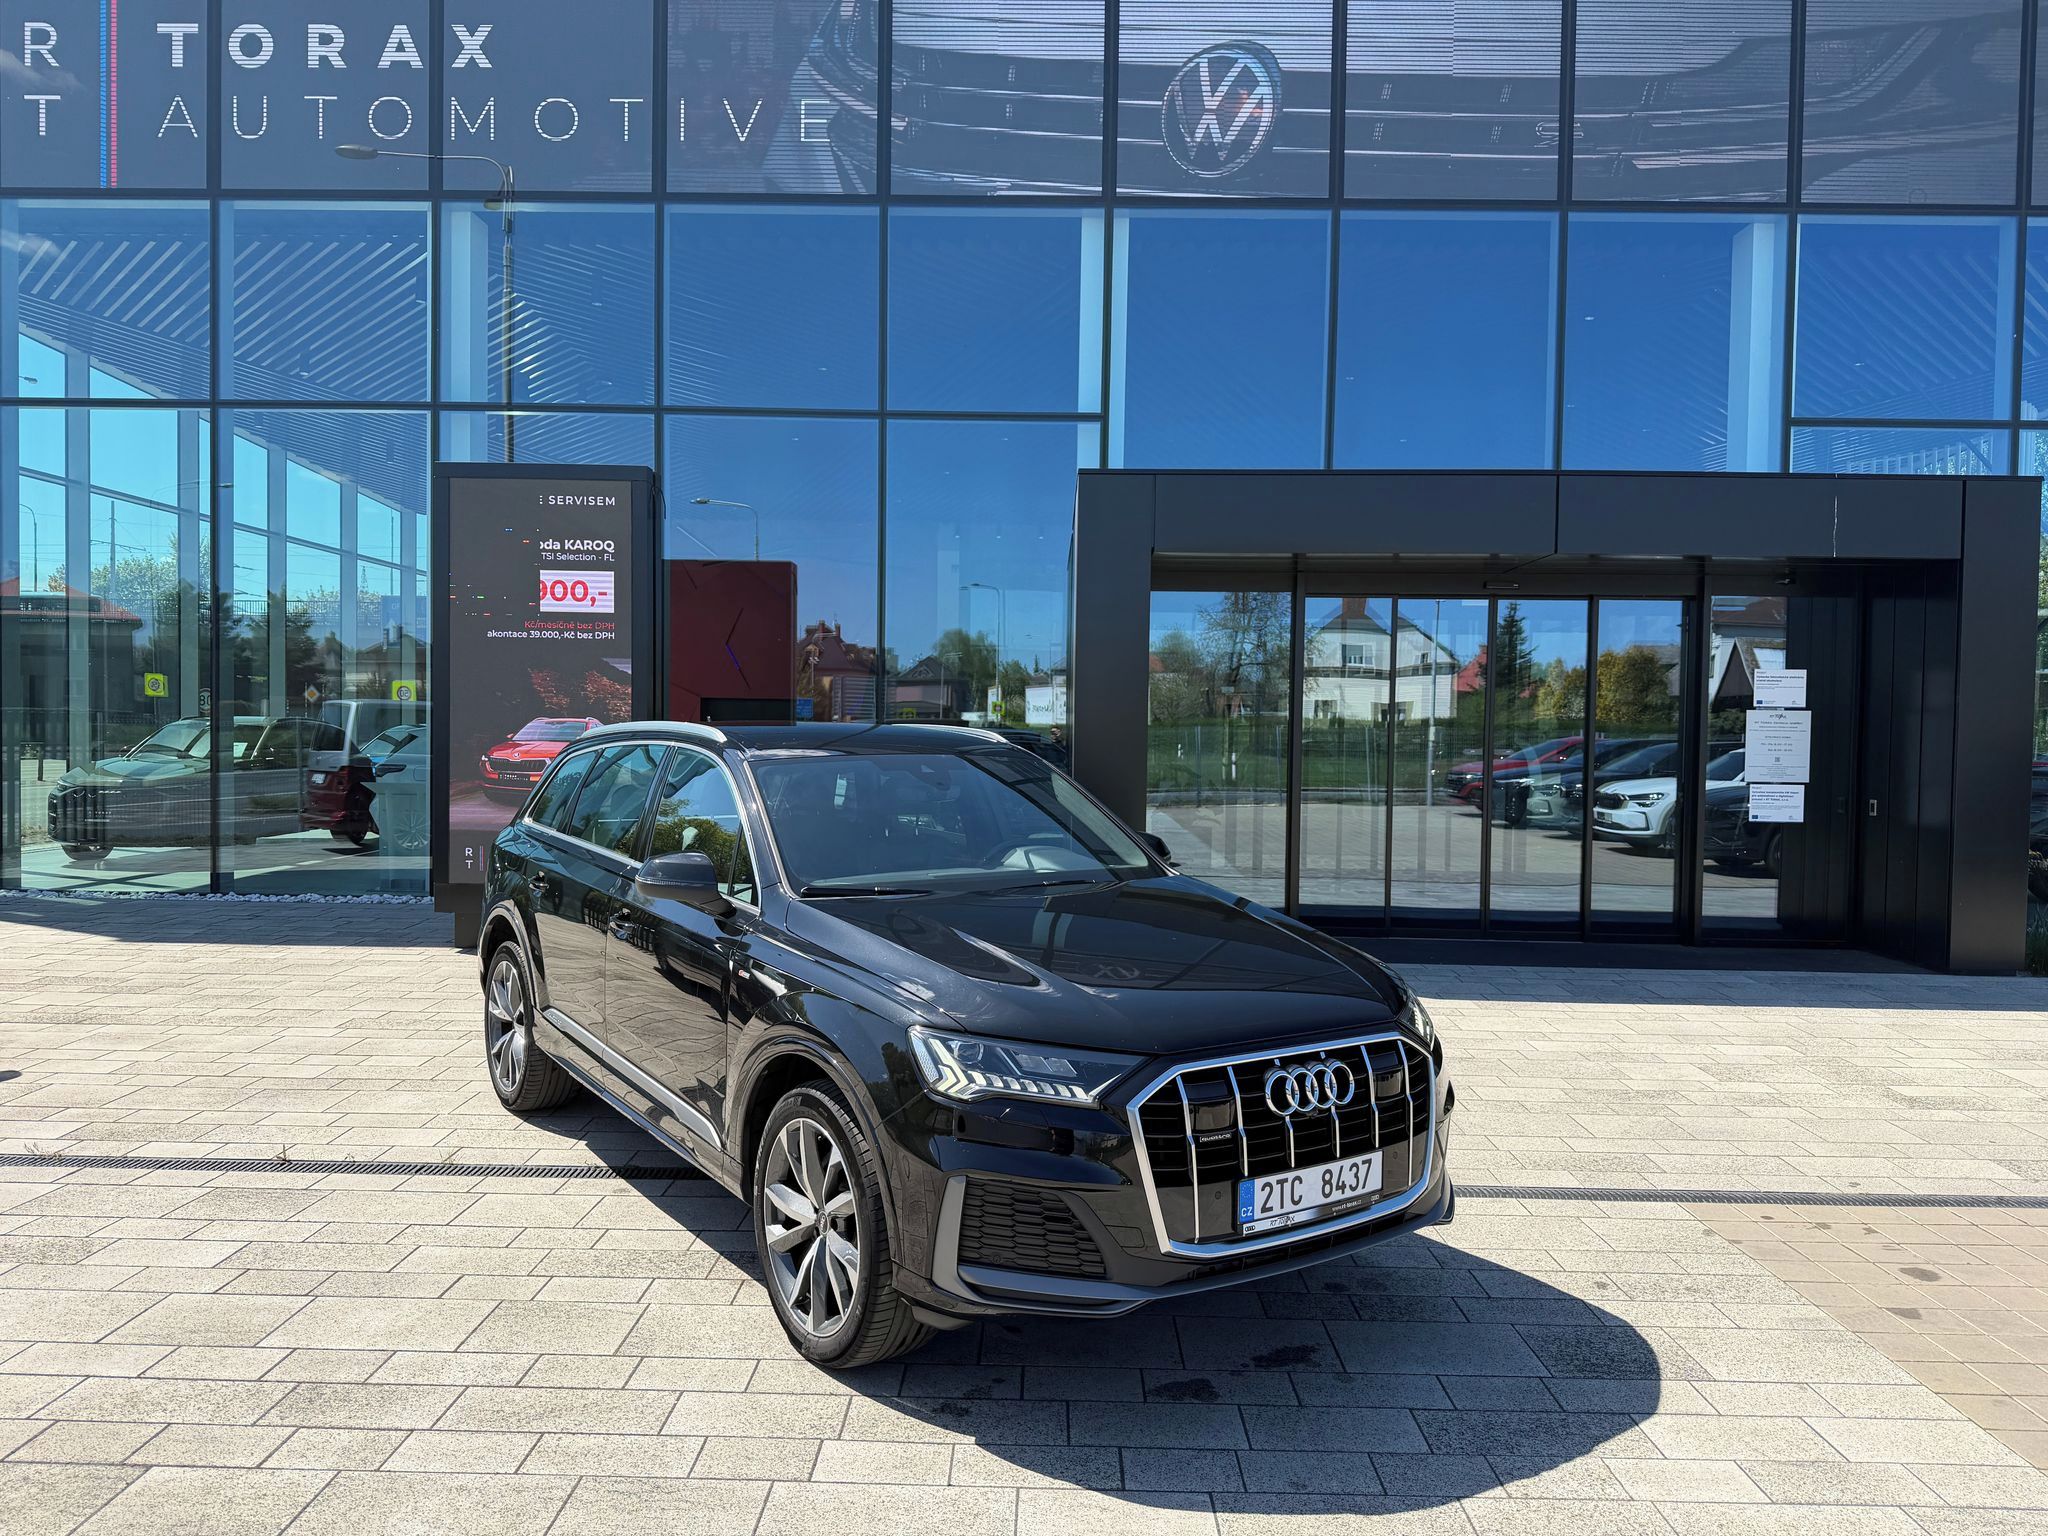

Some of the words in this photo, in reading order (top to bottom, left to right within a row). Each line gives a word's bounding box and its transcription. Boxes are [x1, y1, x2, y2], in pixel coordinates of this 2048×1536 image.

[24, 21, 60, 67] R
[156, 22, 494, 69] TORAX
[24, 94, 61, 137] T
[156, 94, 832, 143] AUTOMOTIVE
[548, 495, 616, 506] SERVISEM
[564, 539, 615, 553] KAROQ
[541, 552, 554, 561] TSI
[556, 552, 597, 562] Selection
[604, 553, 615, 562] FL
[487, 629, 528, 639] akontace
[577, 630, 593, 640] bez
[595, 631, 615, 640] DPH
[465, 847, 473, 857] R
[465, 859, 473, 869] T
[1260, 1175, 1303, 1214] 2TC
[1321, 1158, 1373, 1199] 8437
[1241, 1206, 1253, 1217] CZ
